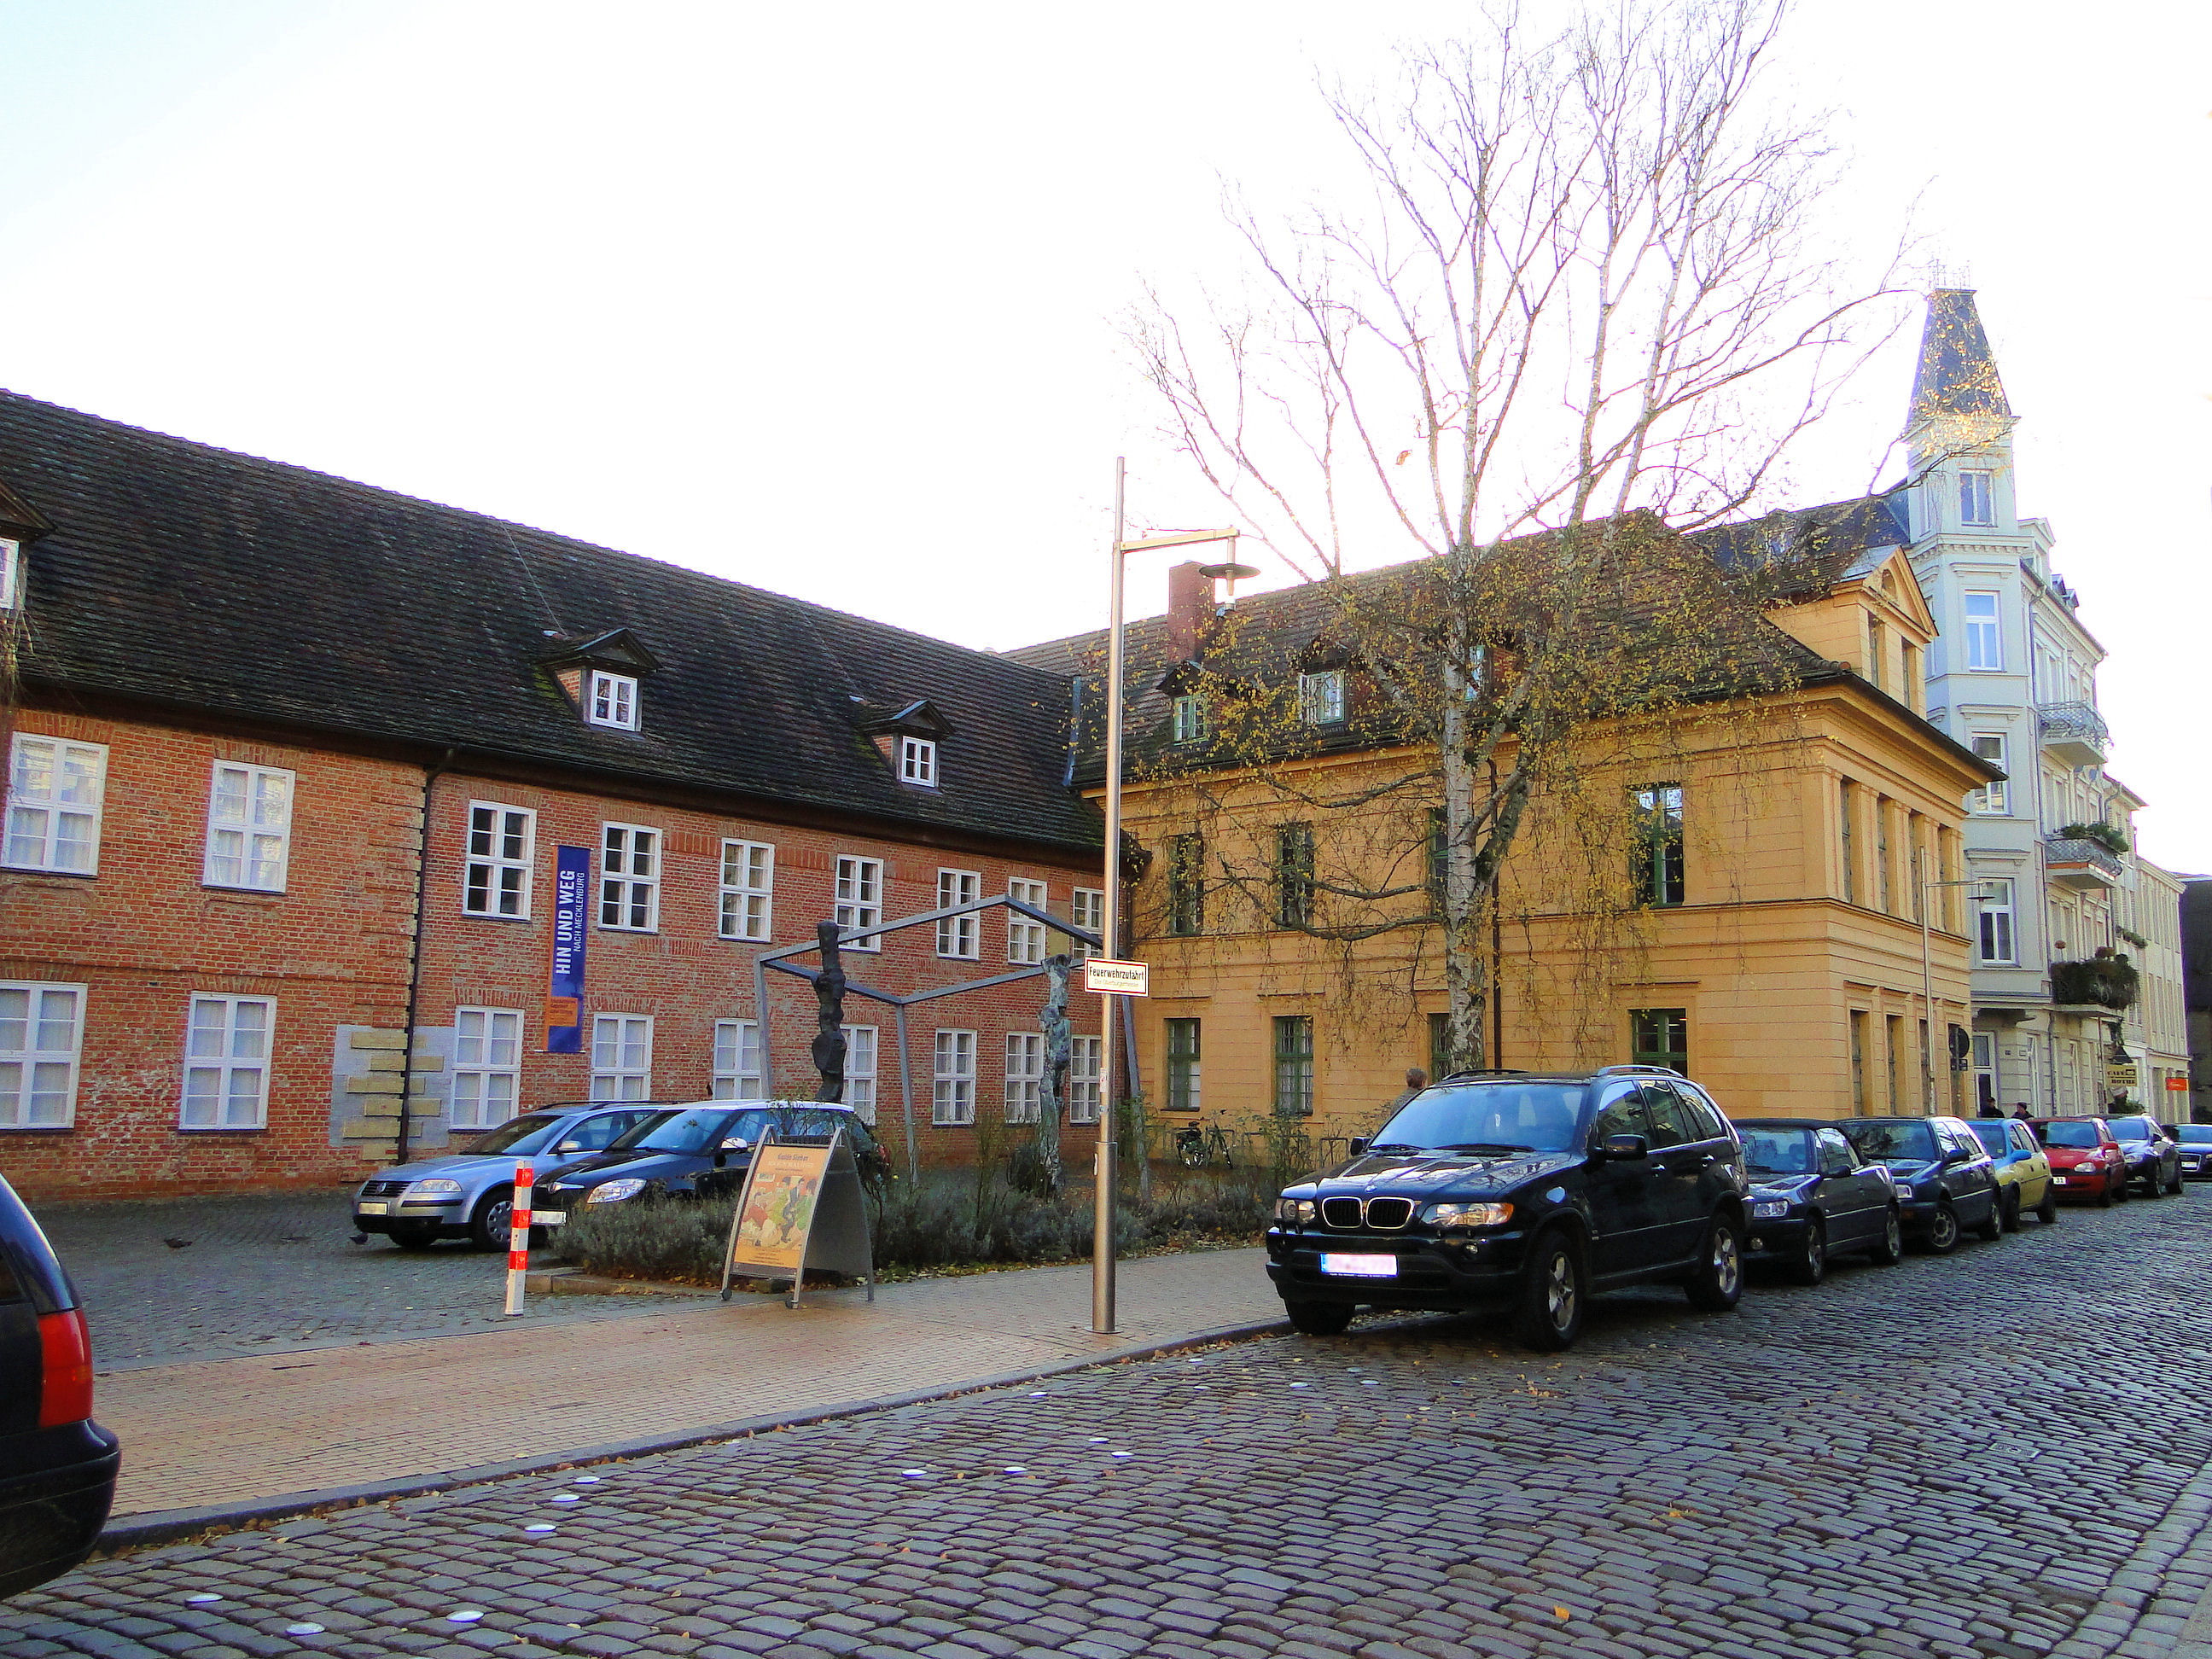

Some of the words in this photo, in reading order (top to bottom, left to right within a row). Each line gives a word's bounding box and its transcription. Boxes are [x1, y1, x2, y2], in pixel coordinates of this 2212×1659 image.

[559, 870, 576, 908] WEG
[575, 872, 585, 928] MECKLENBURG
[557, 910, 573, 941] UND
[573, 929, 582, 952] NACH
[556, 946, 571, 975] HIN
[1089, 966, 1144, 981] Feuerwehrzufahrt
